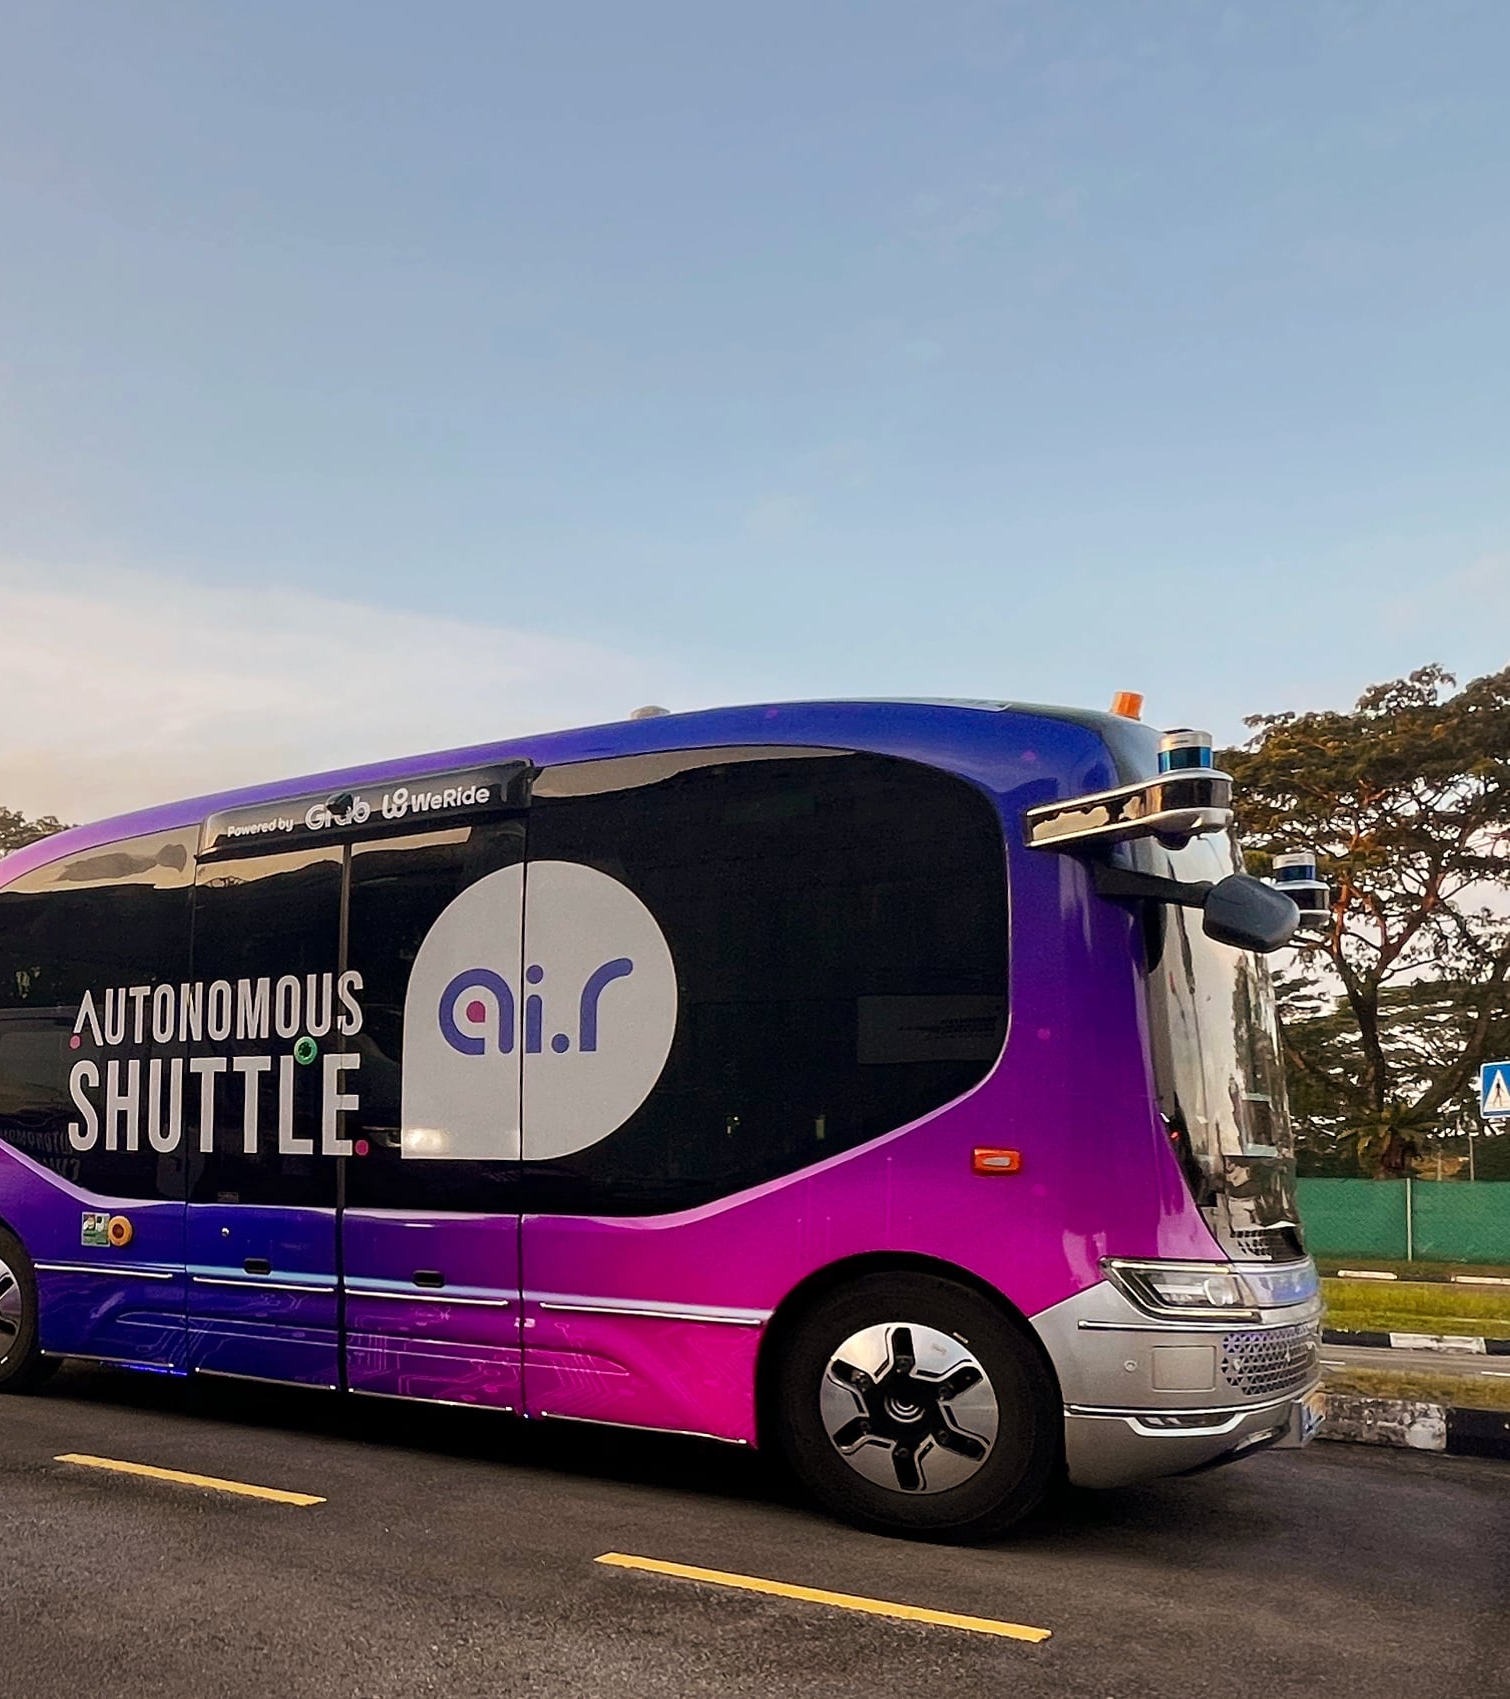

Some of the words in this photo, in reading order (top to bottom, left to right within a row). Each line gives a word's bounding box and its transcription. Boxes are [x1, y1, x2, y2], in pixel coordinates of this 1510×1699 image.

[227, 819, 276, 838] Powered
[277, 818, 294, 833] by
[411, 786, 490, 813] WeRide
[70, 970, 364, 1047] AUTONOMOUS
